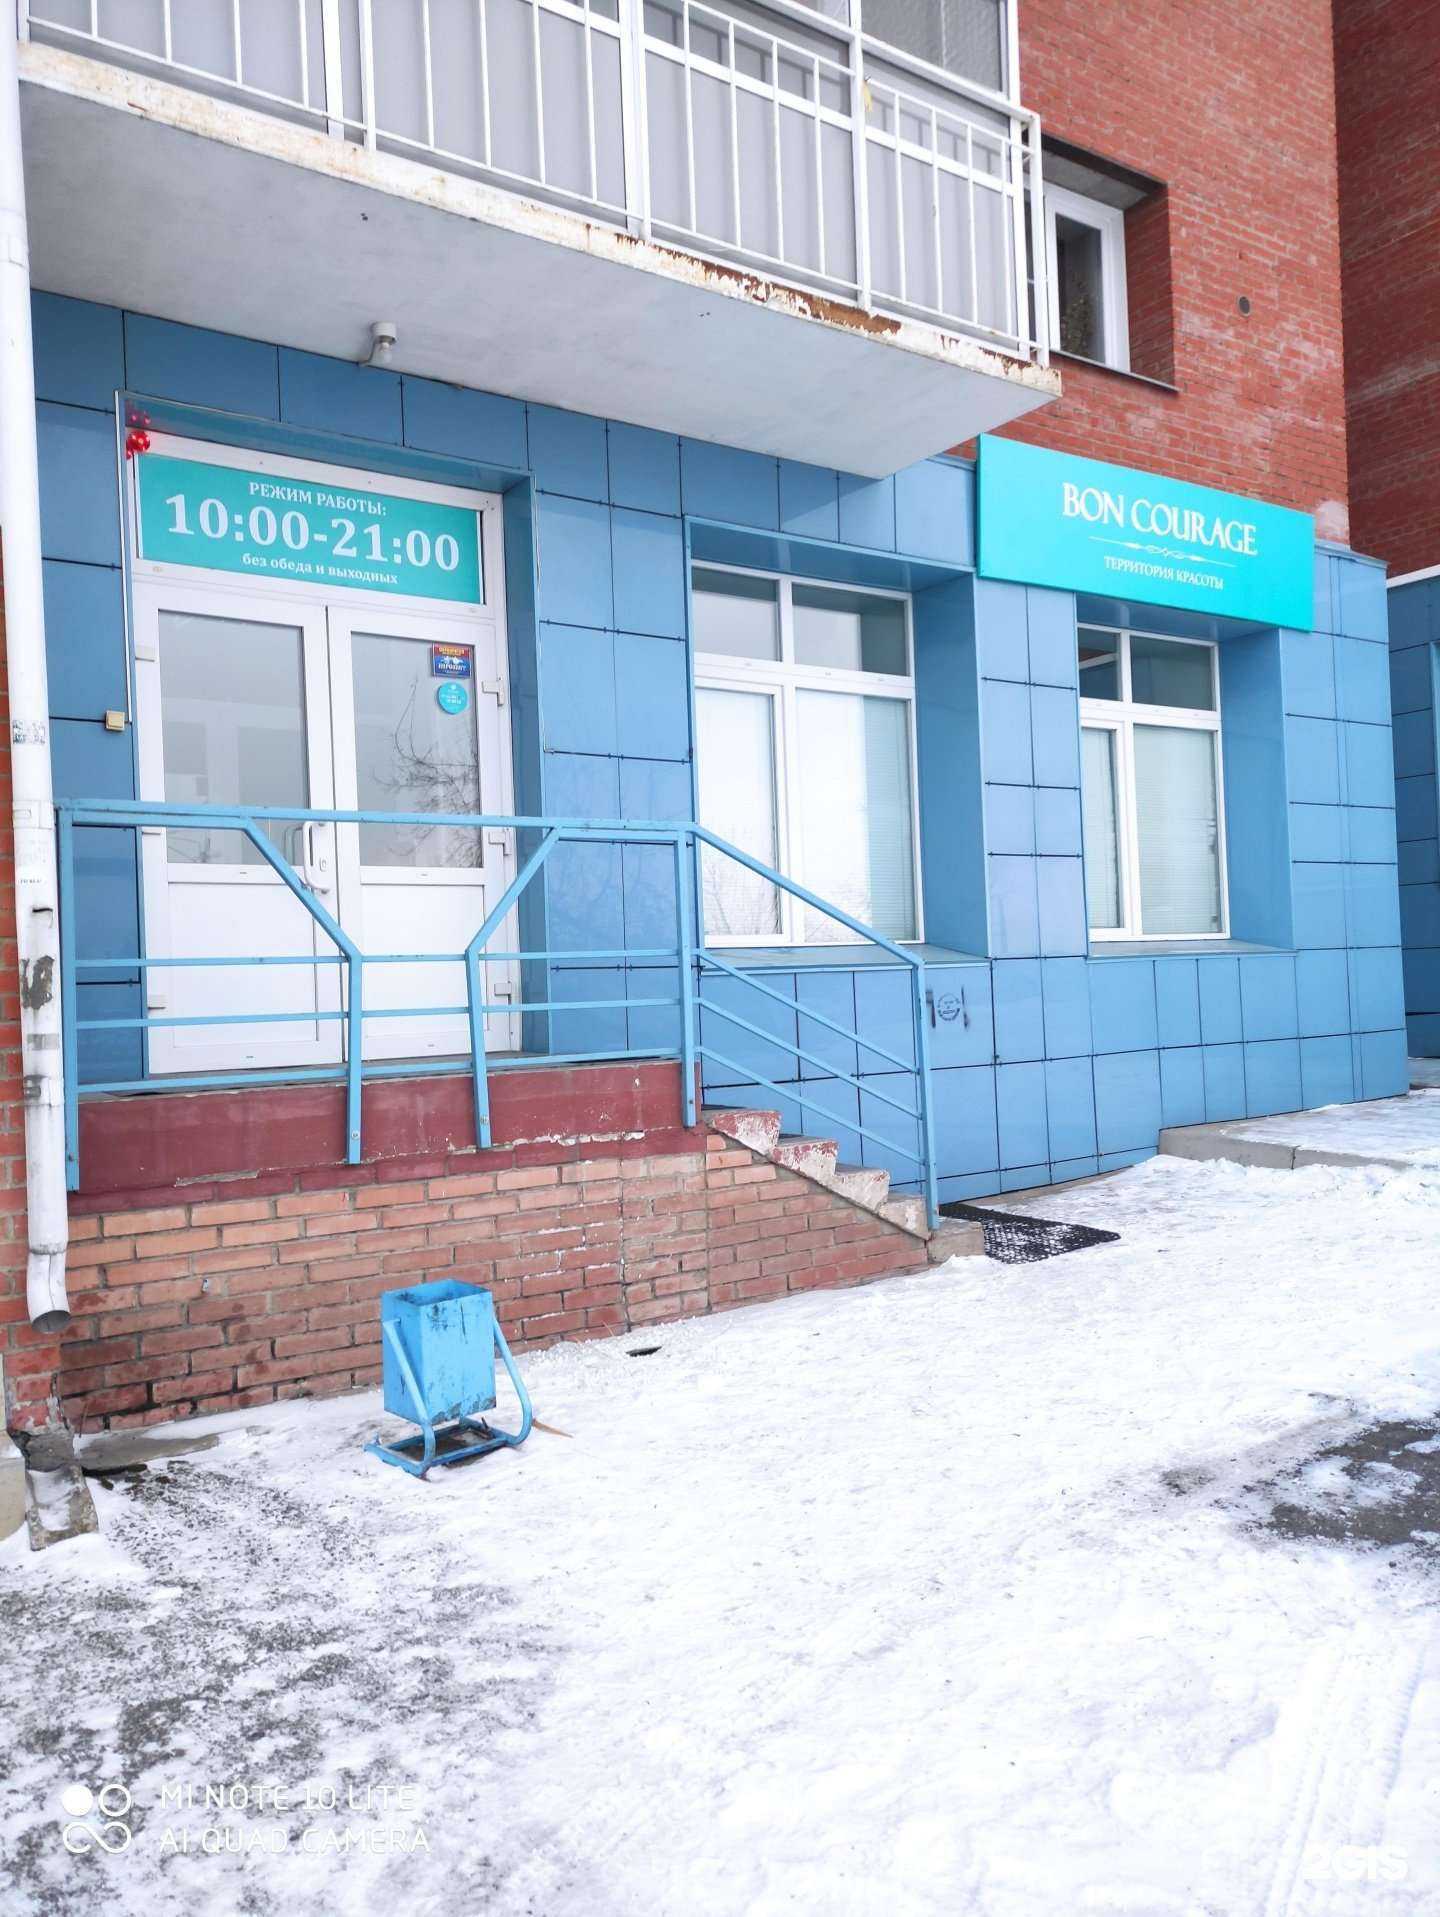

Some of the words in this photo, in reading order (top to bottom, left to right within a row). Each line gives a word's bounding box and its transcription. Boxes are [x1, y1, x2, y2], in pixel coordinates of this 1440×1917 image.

[248, 481, 313, 506] РЕЖИМ
[316, 491, 387, 517] РАБОТЫ:
[165, 493, 460, 571] 10:00-21:00
[1062, 482, 1125, 529] BON
[1130, 498, 1258, 556] COURAGE
[241, 552, 268, 570] без
[270, 556, 313, 575] обеда
[315, 564, 326, 575] и
[327, 566, 400, 585] выходных
[1103, 555, 1175, 581] ТЕРРИТОРИЯ
[1176, 570, 1224, 591] КРАСОТЫ
